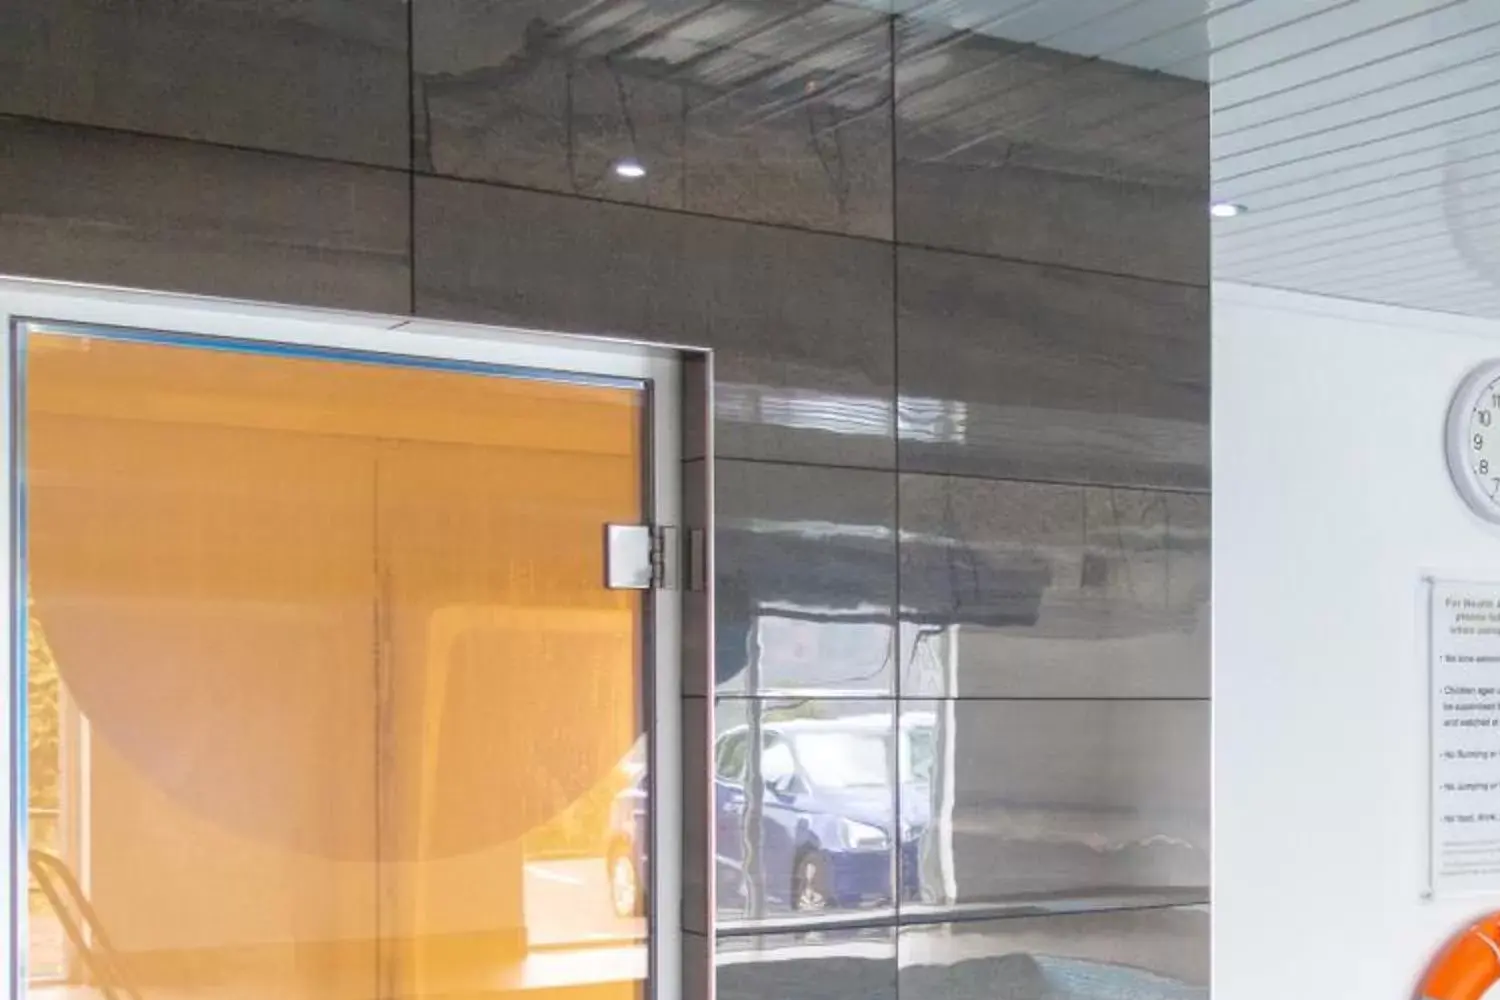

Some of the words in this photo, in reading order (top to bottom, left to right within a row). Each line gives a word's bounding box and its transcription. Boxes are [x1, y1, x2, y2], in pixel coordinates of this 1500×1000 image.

[1492, 394, 1500, 409] 11
[1478, 410, 1491, 427] 10
[1473, 434, 1483, 450] 9
[1479, 459, 1488, 475] 8
